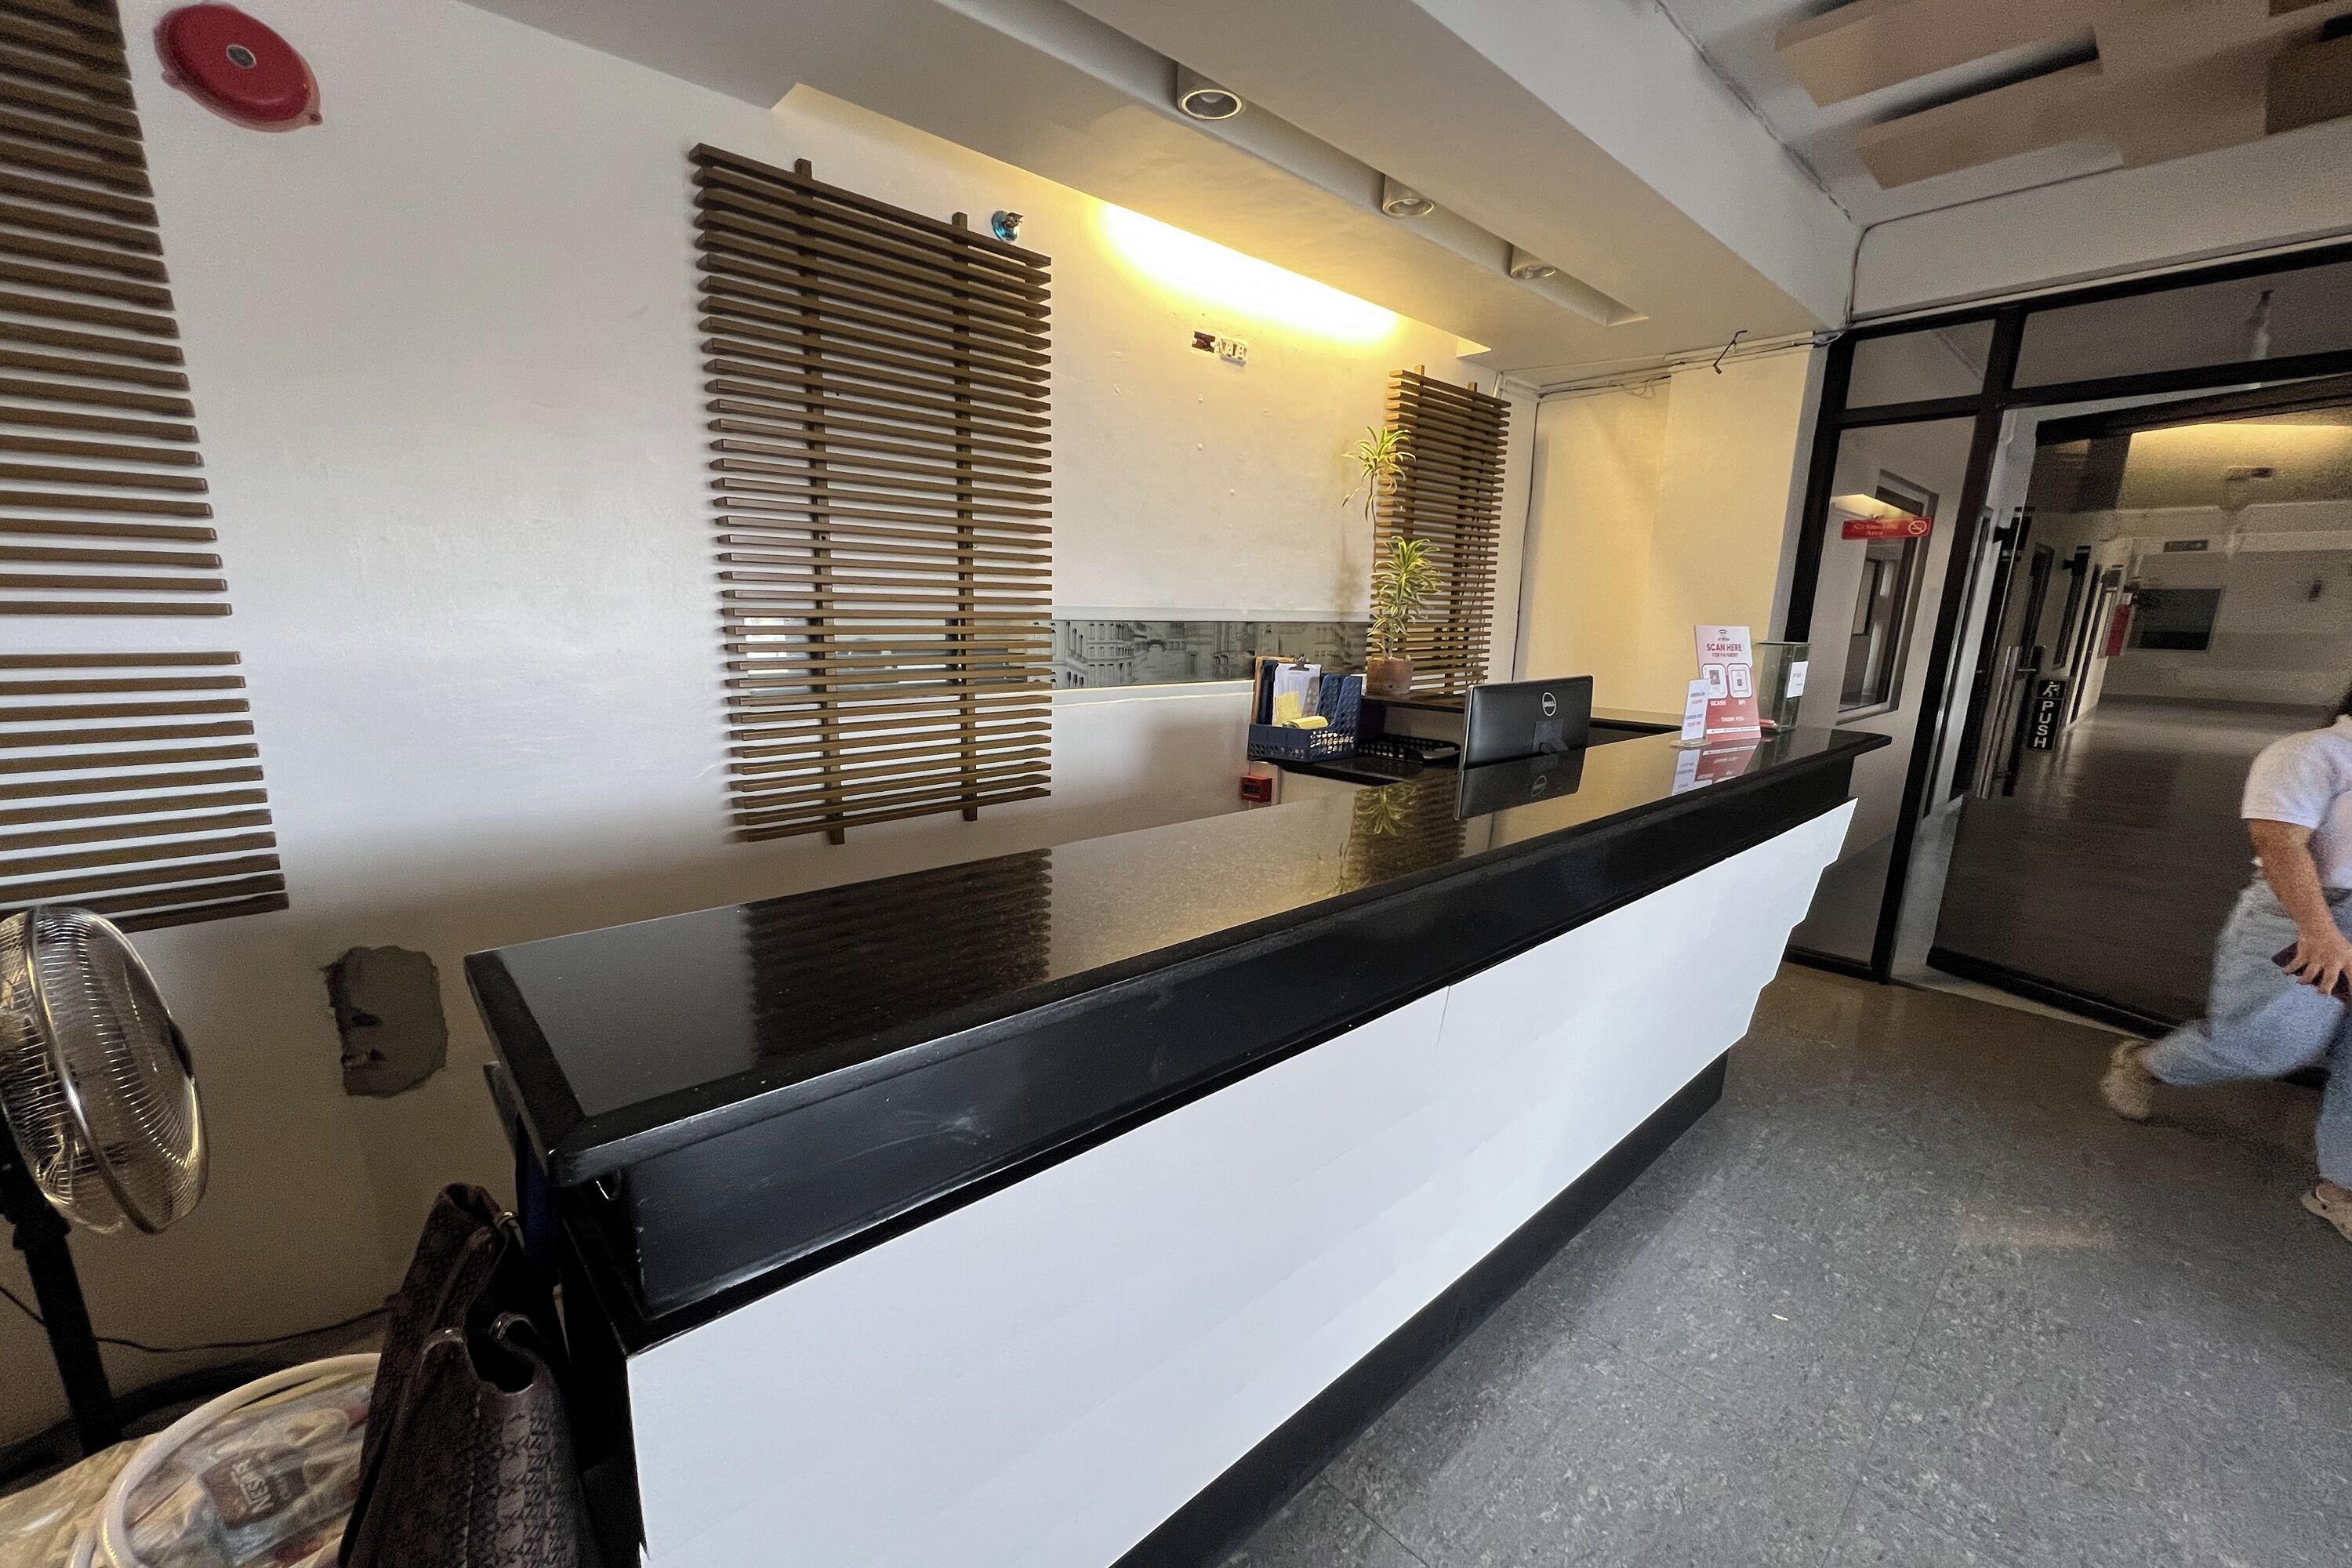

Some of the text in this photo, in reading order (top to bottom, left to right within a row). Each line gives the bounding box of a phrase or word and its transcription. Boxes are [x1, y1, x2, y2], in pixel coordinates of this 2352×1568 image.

[1706, 643, 1742, 652] SCAN HERE
[2032, 699, 2055, 749] PUSH
